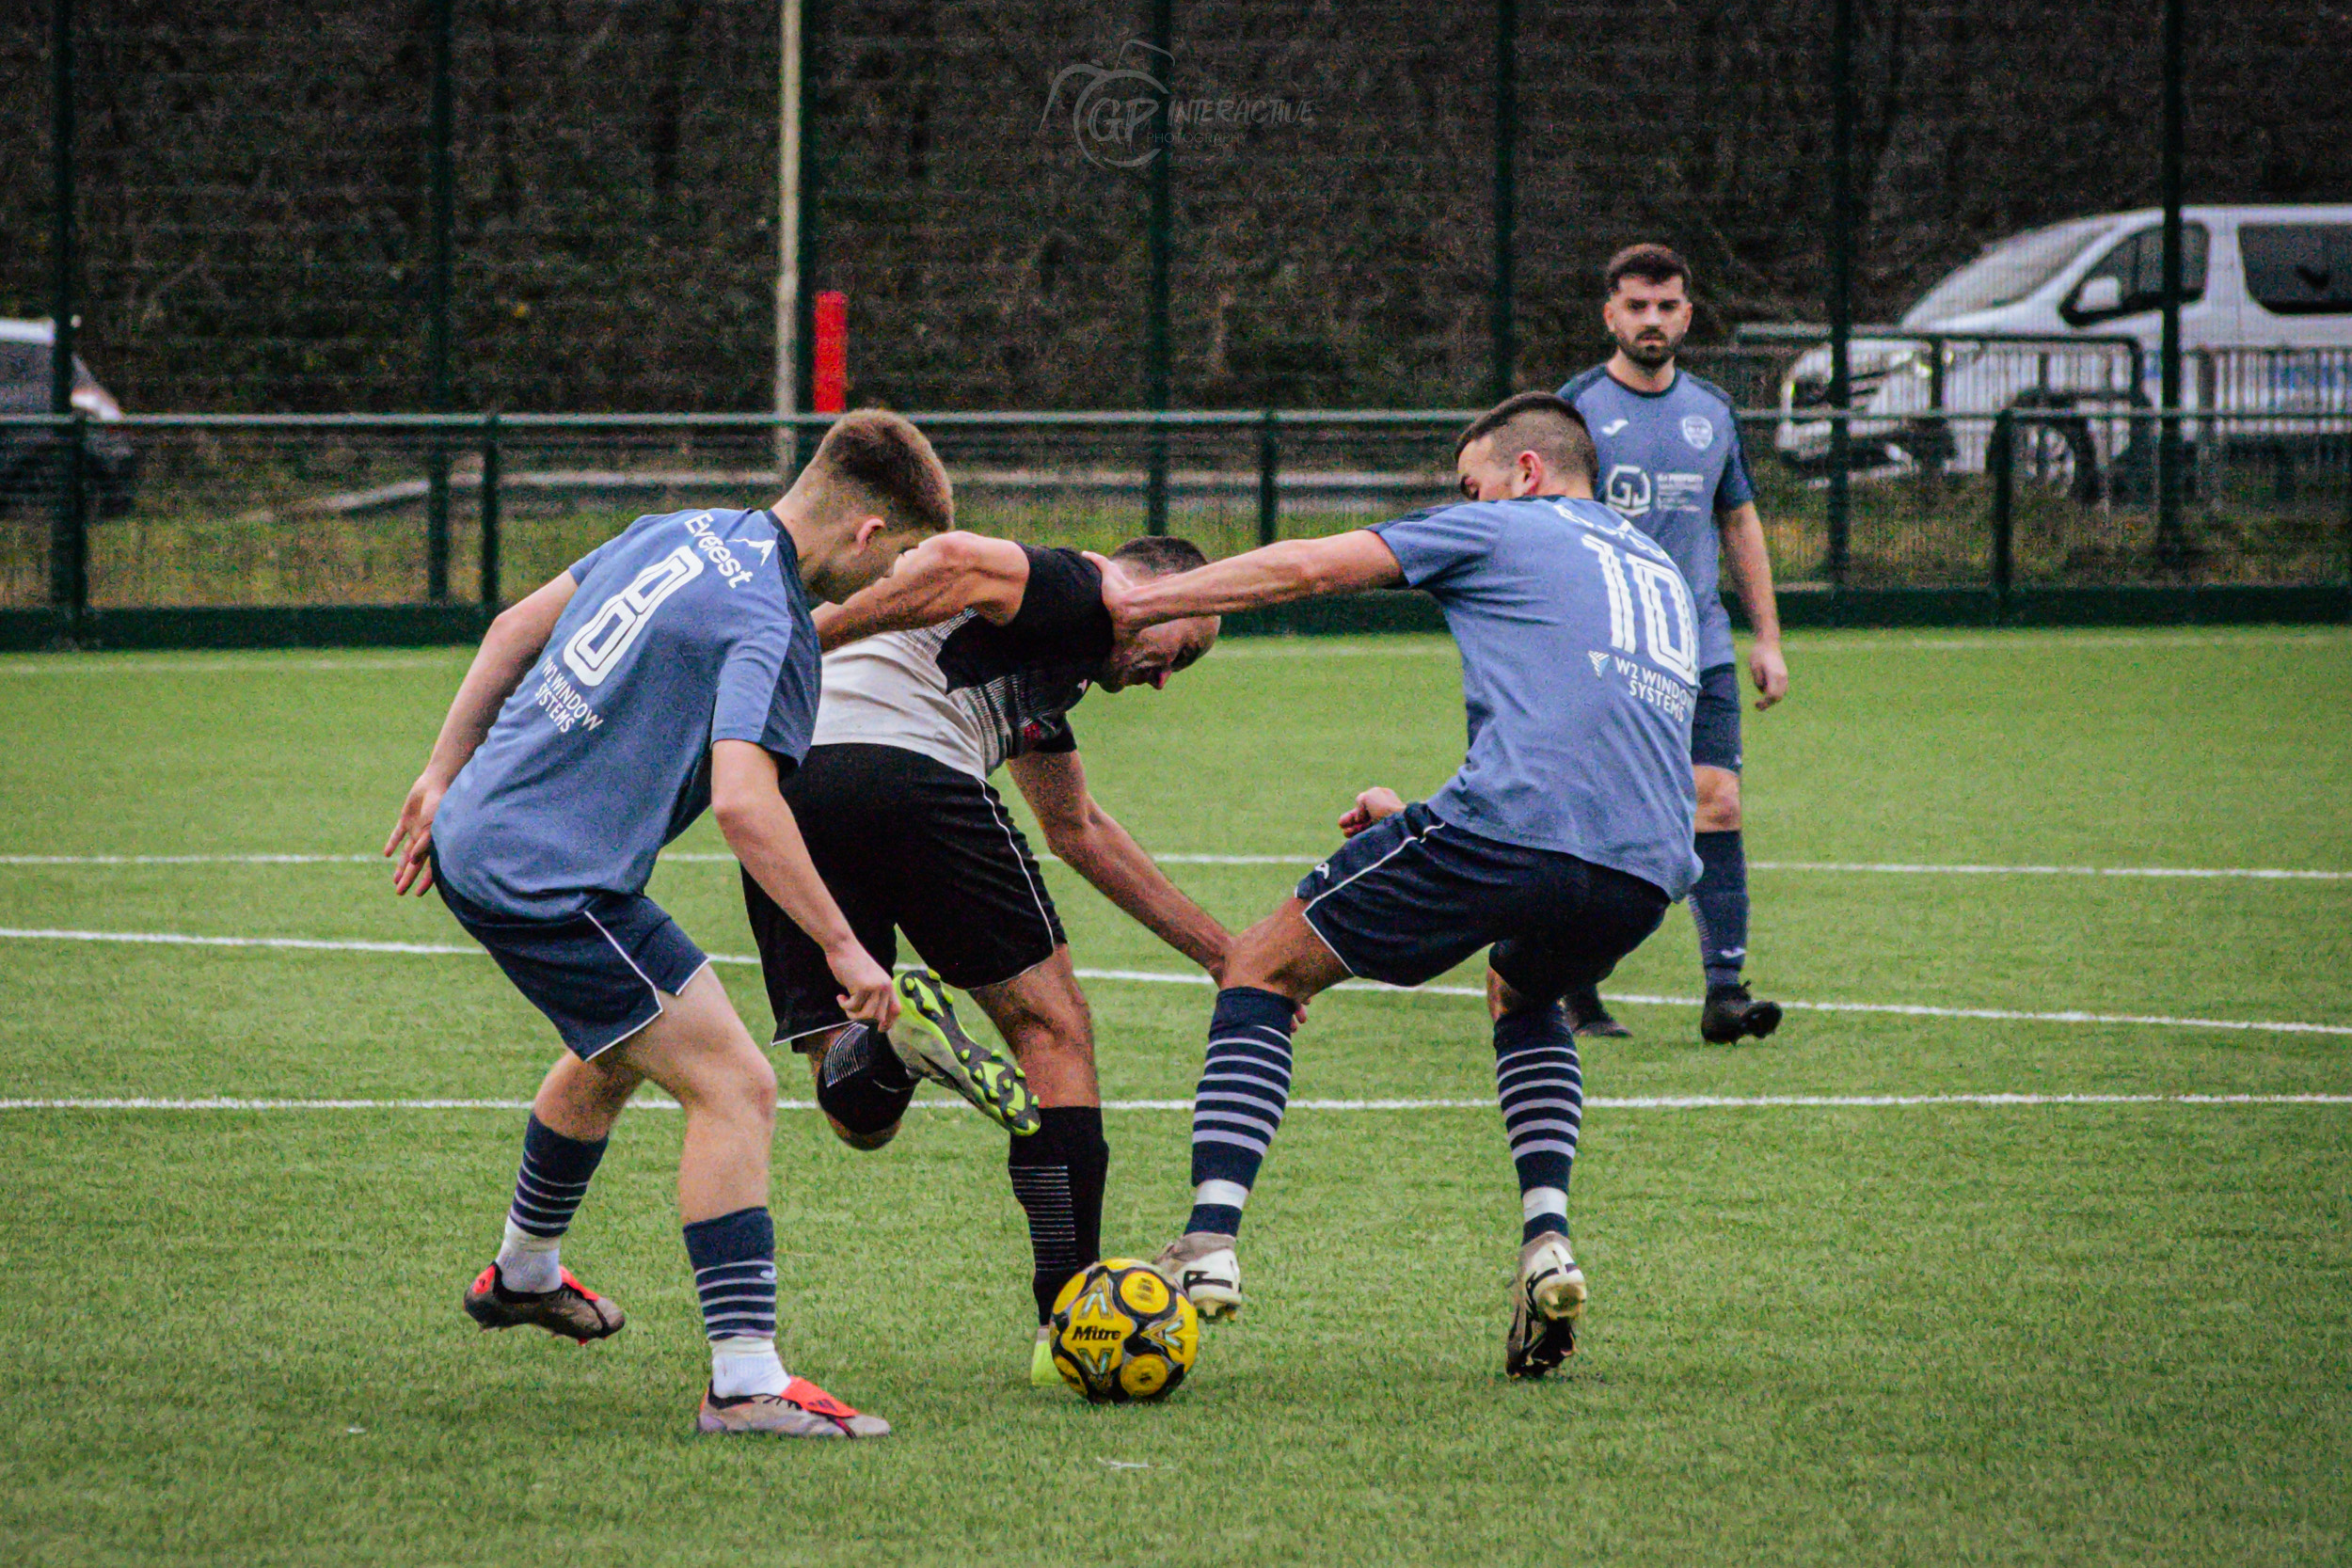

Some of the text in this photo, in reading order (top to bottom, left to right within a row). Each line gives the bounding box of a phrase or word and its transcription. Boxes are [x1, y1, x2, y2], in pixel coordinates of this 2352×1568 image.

[563, 545, 705, 687] 8
[1581, 533, 1699, 688] 10
[1614, 657, 1639, 679] W2
[535, 683, 576, 733] SYSTEMS
[550, 673, 604, 731] WINDOW
[1629, 679, 1685, 722] SYSTEMS
[1072, 1325, 1121, 1342] Mitre
